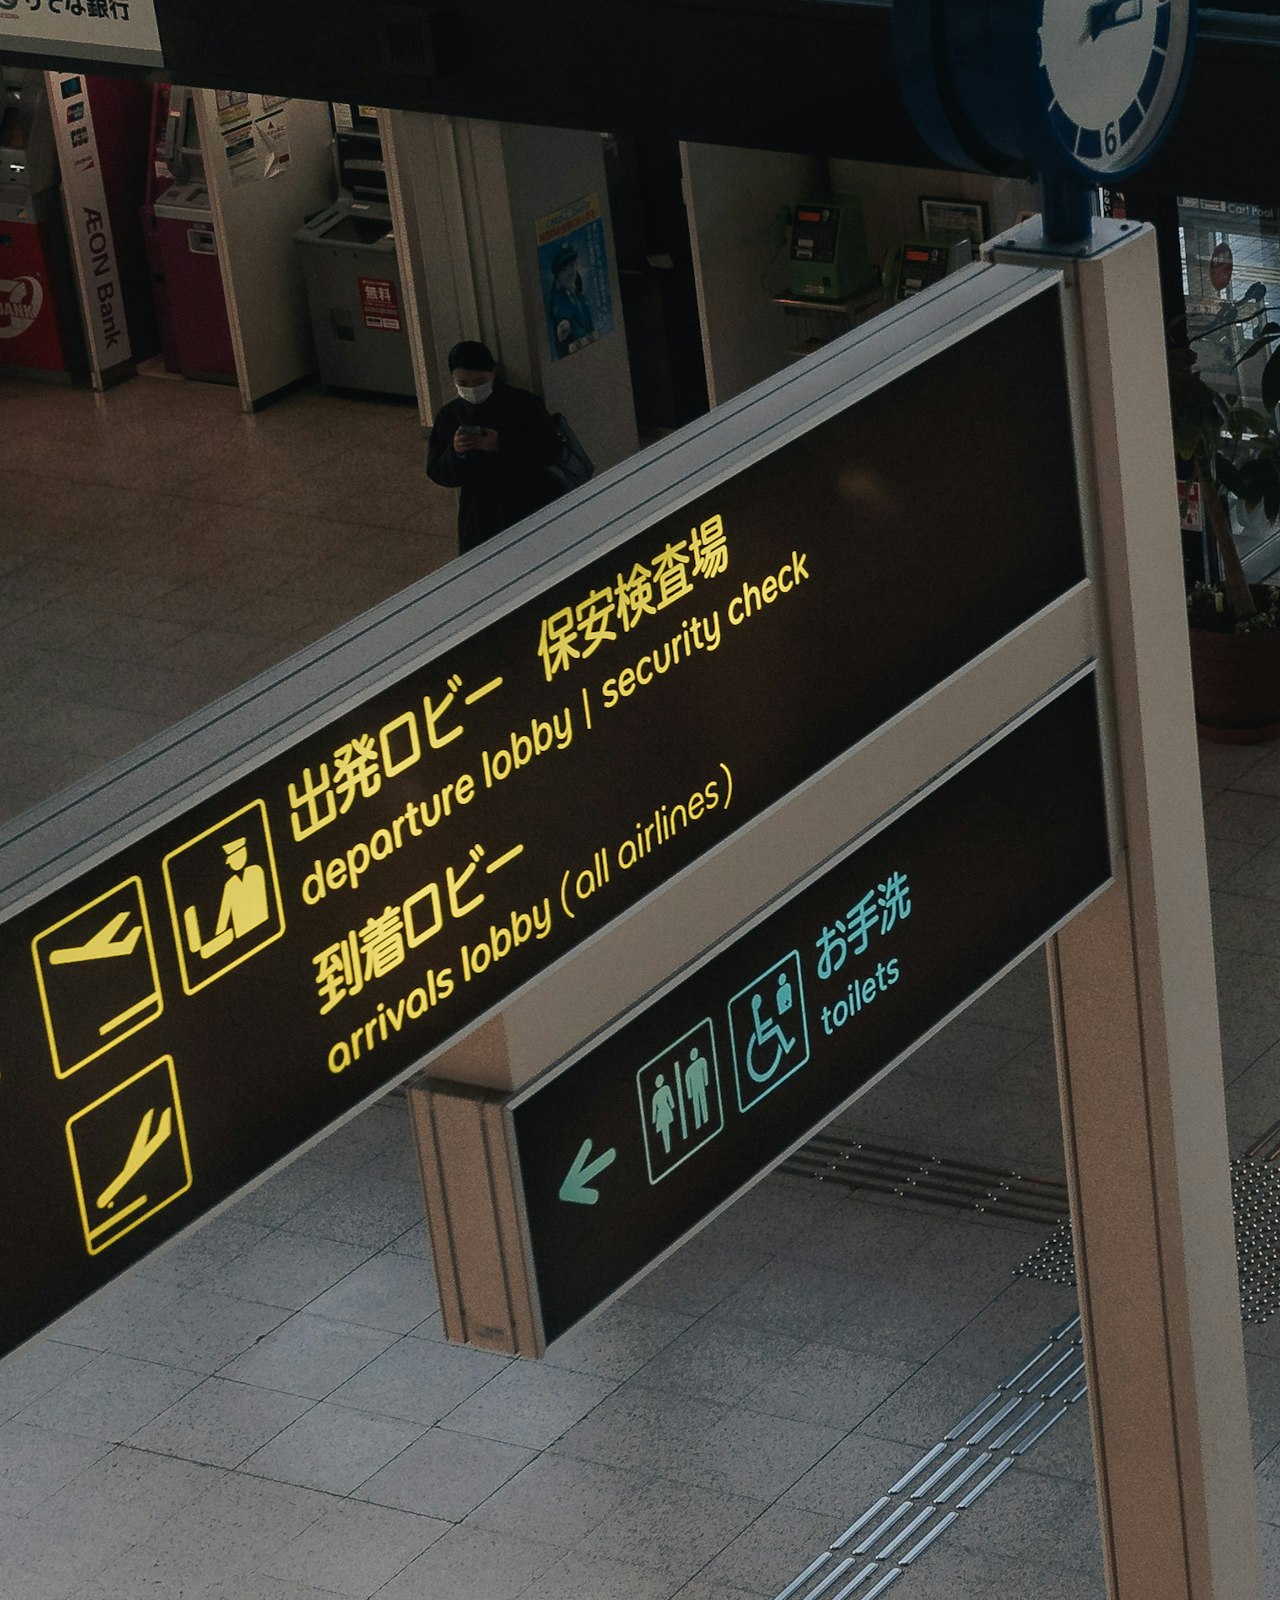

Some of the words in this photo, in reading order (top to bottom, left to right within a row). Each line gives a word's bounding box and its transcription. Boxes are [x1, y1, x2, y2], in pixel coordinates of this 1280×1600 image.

[1104, 121, 1117, 156] 6
[1251, 206, 1274, 219] Pool
[96, 281, 122, 350] Bank
[364, 285, 392, 302] 無料
[287, 675, 504, 843] 出発ロビー
[538, 514, 730, 683] 保安検査場
[302, 775, 476, 907] departure
[482, 707, 574, 790] lobby
[602, 618, 722, 710] security
[728, 551, 811, 627] check
[312, 844, 525, 1017] 到着ロビー
[328, 968, 456, 1075] arrivals
[461, 898, 553, 983] lobby
[561, 848, 611, 920] (all
[618, 763, 734, 871] airlines)
[816, 872, 913, 981] お手洗
[822, 958, 901, 1036] toilets
